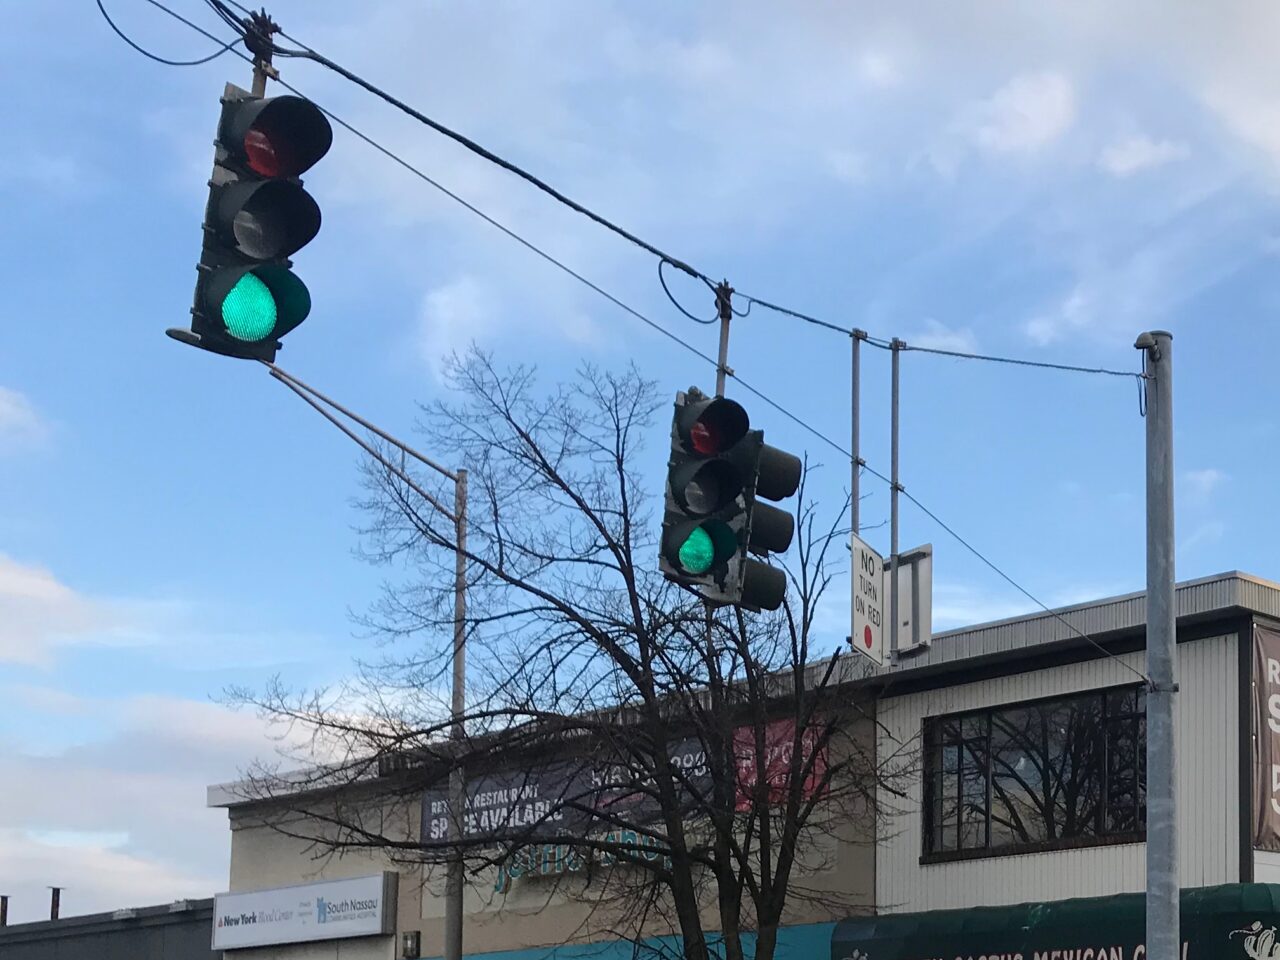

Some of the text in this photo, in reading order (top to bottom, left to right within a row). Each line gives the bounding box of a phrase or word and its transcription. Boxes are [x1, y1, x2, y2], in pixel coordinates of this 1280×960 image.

[861, 549, 875, 577] NO
[859, 574, 877, 603] TURN
[855, 595, 881, 627] ON RED
[223, 915, 240, 927] New
[240, 911, 257, 925] York
[327, 900, 349, 915] South
[350, 897, 378, 912] Nassau
